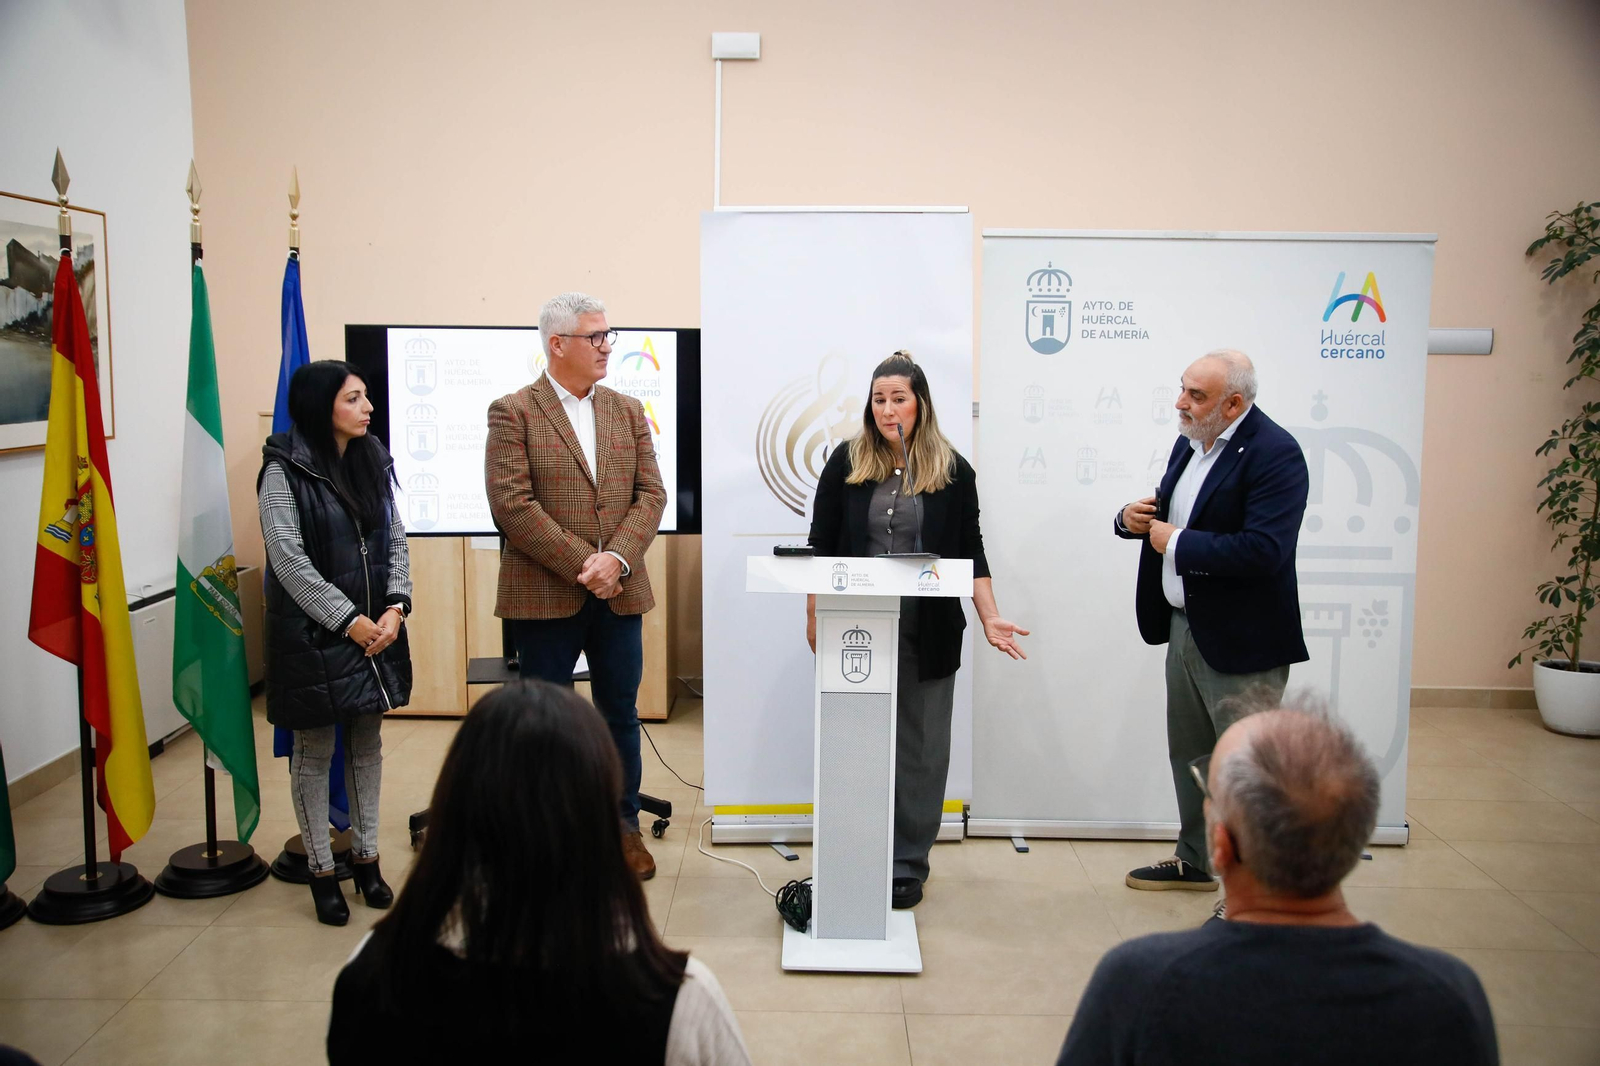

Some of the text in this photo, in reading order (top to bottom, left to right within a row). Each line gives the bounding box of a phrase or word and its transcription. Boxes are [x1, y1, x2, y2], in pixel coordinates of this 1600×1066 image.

[1082, 300, 1134, 311] AYTO. DE
[1081, 312, 1137, 325] HUÉRCAL
[1081, 327, 1150, 340] DE ALMERÍA
[1320, 328, 1386, 346] Huércal
[1320, 347, 1386, 360] cercano
[469, 358, 482, 367] DE
[444, 378, 456, 386] DE
[614, 375, 661, 388] Huércal
[616, 389, 661, 397] ercano
[470, 424, 482, 432] DE
[445, 443, 485, 451] DE ALMER
[471, 493, 483, 501] DE
[447, 512, 458, 520] DE
